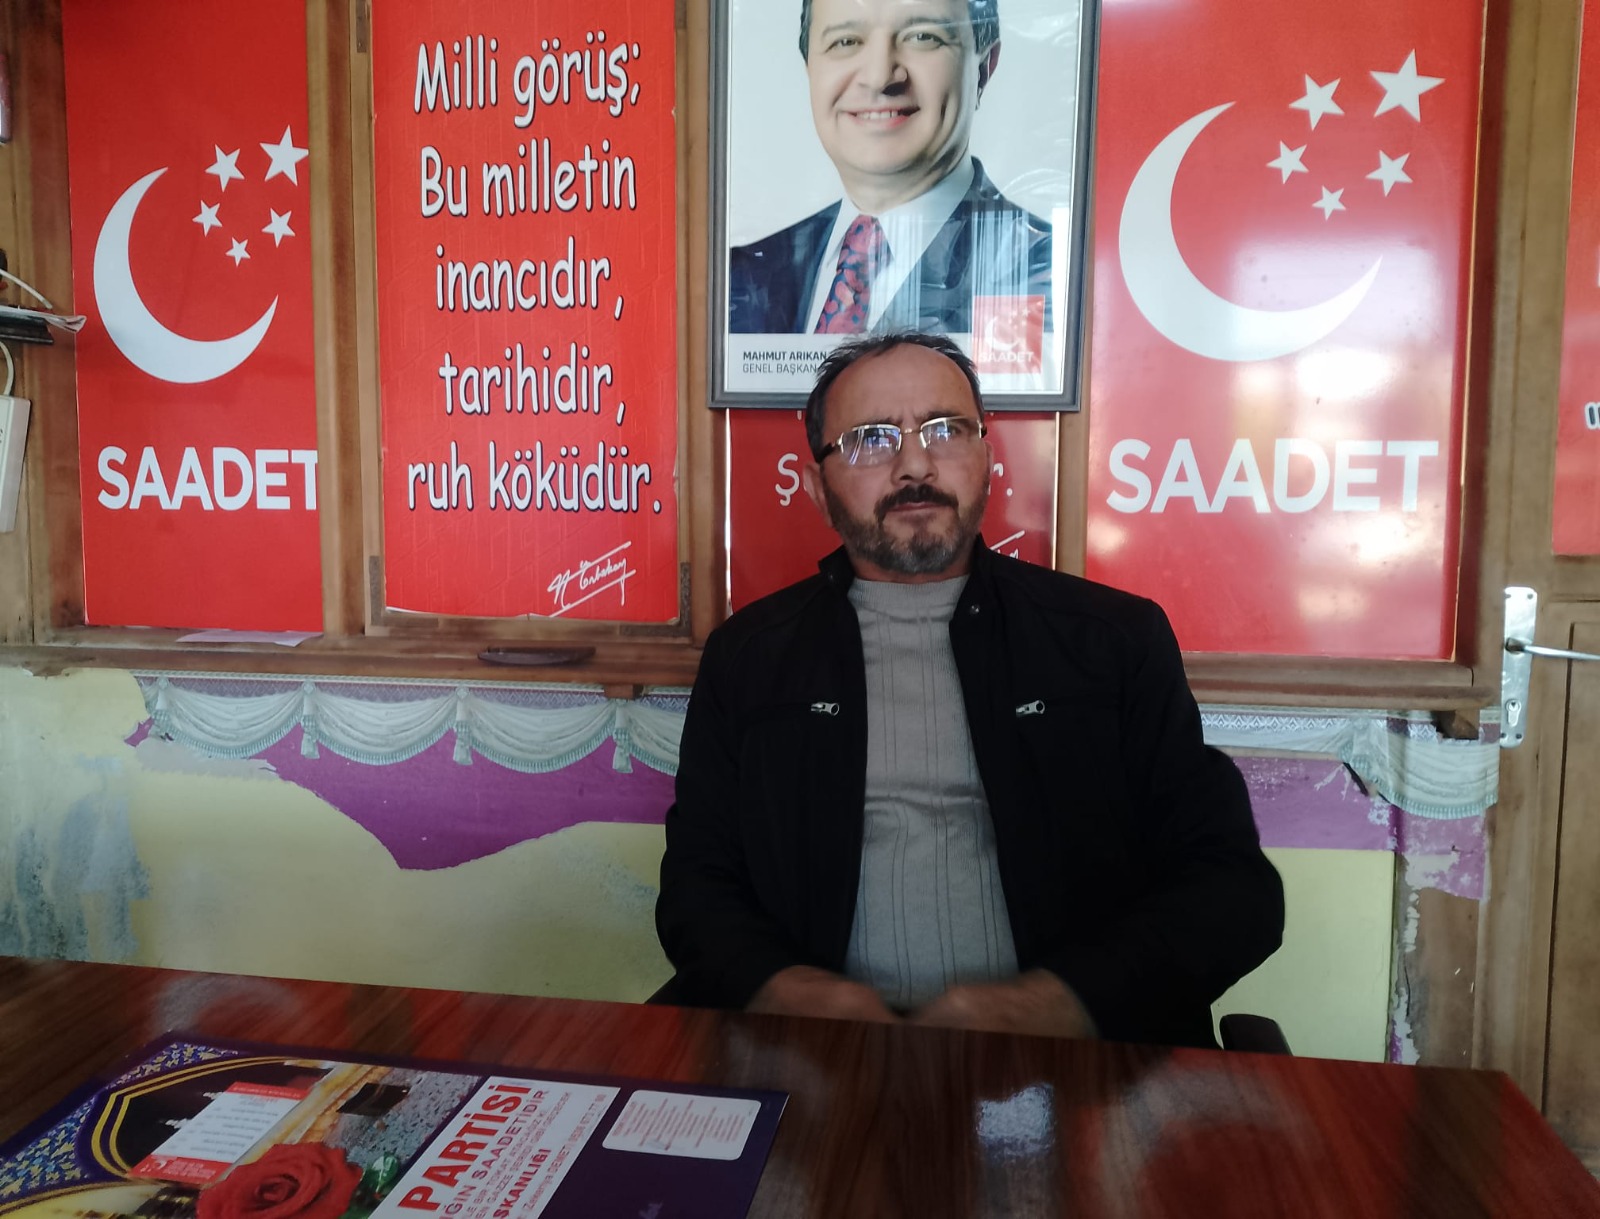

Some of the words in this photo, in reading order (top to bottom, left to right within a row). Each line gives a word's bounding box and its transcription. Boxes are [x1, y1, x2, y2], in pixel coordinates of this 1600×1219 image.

[413, 34, 498, 114] Milli
[513, 30, 640, 128] görüş;
[420, 145, 468, 217] Bu
[482, 137, 637, 217] milletin
[742, 363, 774, 374] GENEL
[743, 351, 787, 361] MAHMUT
[789, 351, 827, 361] ARIKAN
[980, 351, 1034, 363] SAADET
[97, 446, 319, 511] SAADET
[407, 440, 474, 511] ruh
[488, 440, 663, 515] köküdür.
[1105, 438, 1440, 514] SAADET
[398, 1084, 532, 1212] PARTİSİ
[471, 1090, 549, 1180] SAADETİDİR
